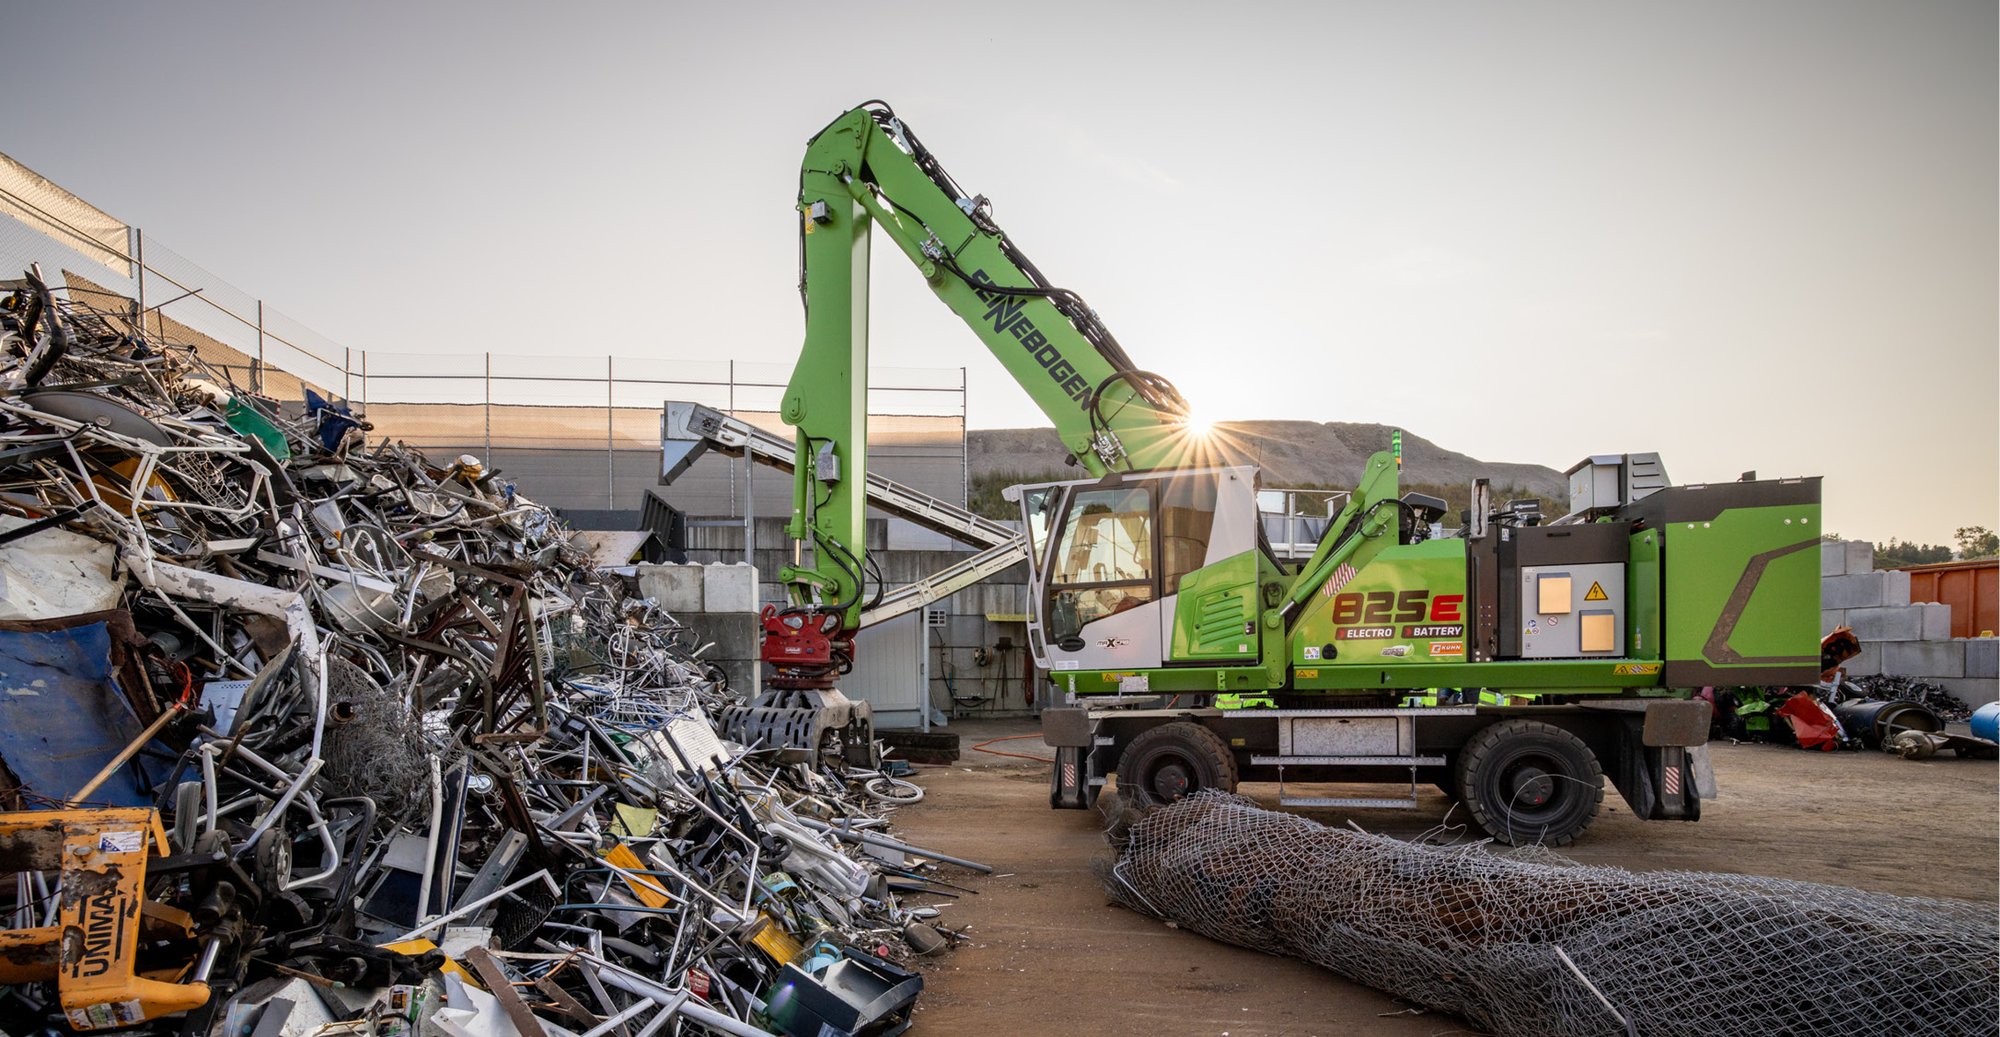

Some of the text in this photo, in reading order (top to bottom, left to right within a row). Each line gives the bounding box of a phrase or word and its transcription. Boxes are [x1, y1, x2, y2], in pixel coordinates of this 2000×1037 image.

[1332, 590, 1464, 625] 825E
[1347, 626, 1462, 638] ELECTRO BATTERY
[83, 886, 116, 977] UNIMA
